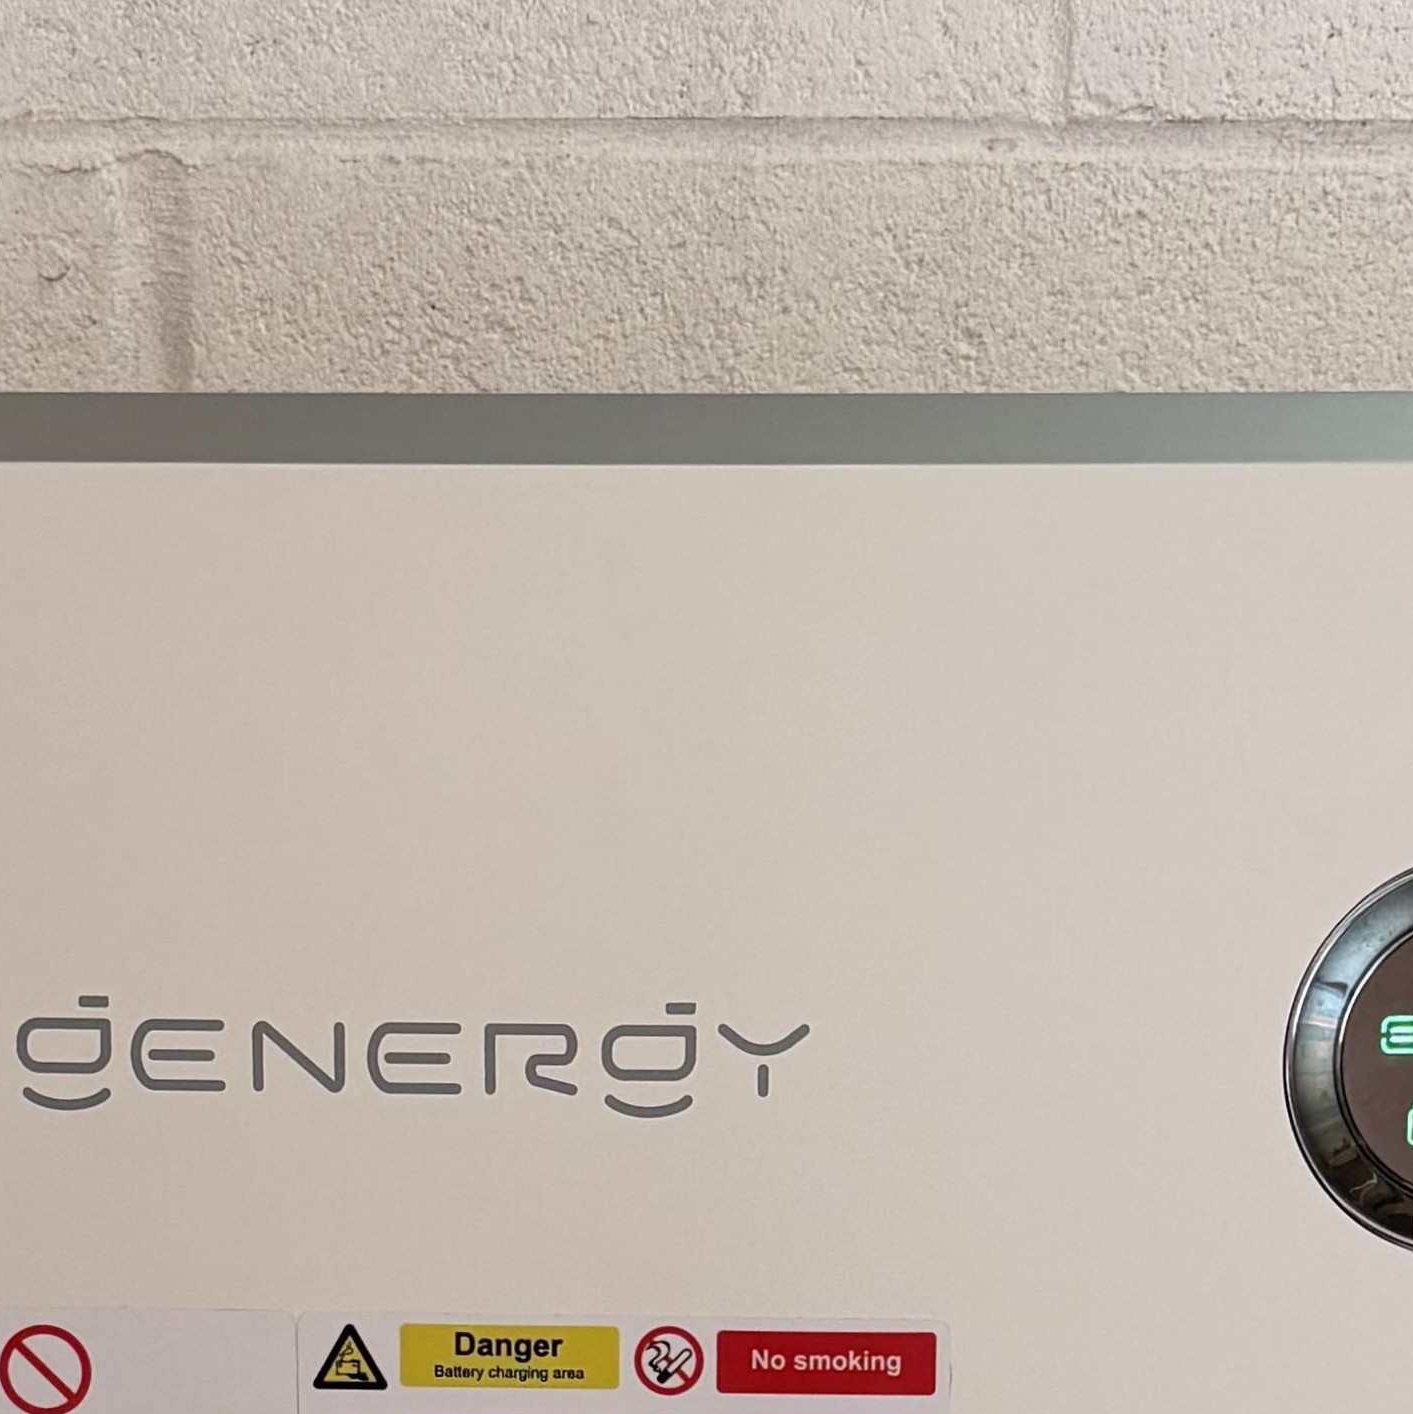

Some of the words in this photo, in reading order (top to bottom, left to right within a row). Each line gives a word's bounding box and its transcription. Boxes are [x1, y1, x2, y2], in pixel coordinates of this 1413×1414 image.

[454, 1333, 564, 1362] Danger
[434, 1365, 485, 1383] Battery
[488, 1365, 550, 1384] charging
[554, 1368, 585, 1380] area
[751, 1350, 789, 1371] No
[793, 1350, 902, 1378] smoking
